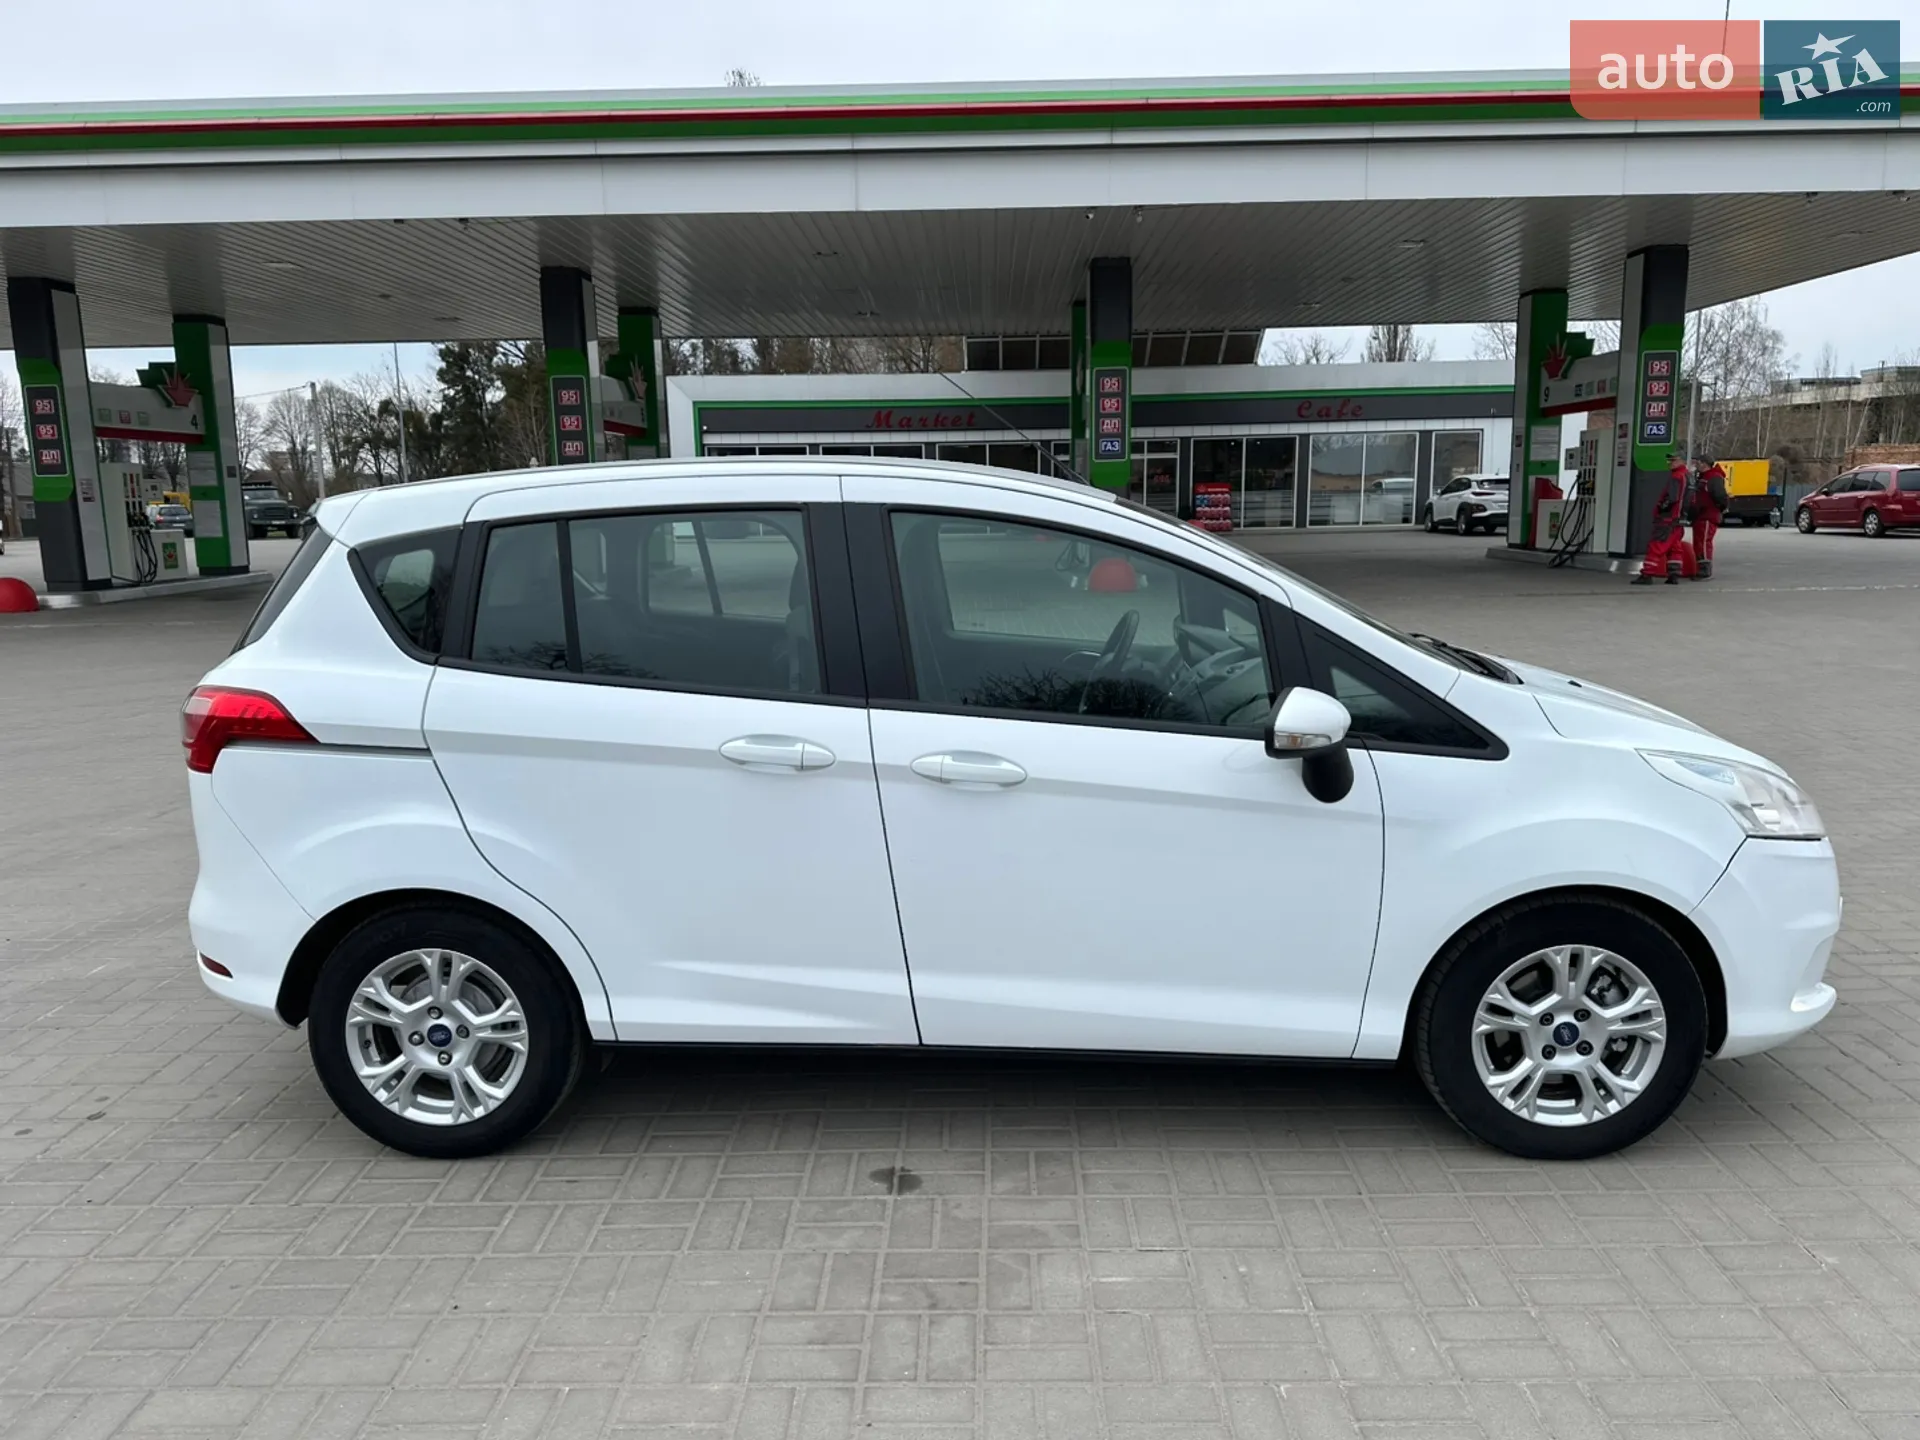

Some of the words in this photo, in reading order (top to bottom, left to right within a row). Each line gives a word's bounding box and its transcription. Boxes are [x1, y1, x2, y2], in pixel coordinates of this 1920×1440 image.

[1652, 361, 1667, 372] 95
[1104, 378, 1118, 389] 95
[1651, 382, 1665, 393] 95
[561, 390, 576, 400] 95
[35, 400, 51, 410] 95
[1104, 399, 1117, 409] 95
[1297, 399, 1363, 418] Cafe
[1649, 402, 1666, 412] ДП
[191, 413, 198, 430] 4
[563, 416, 577, 426] 95
[865, 410, 976, 428] Market
[1103, 420, 1118, 429] ДП
[38, 425, 53, 435] 95
[1647, 425, 1665, 435] ГАЗ
[565, 442, 580, 452] ДП
[1101, 441, 1119, 451] ГАЗ
[41, 450, 57, 460] ДП
